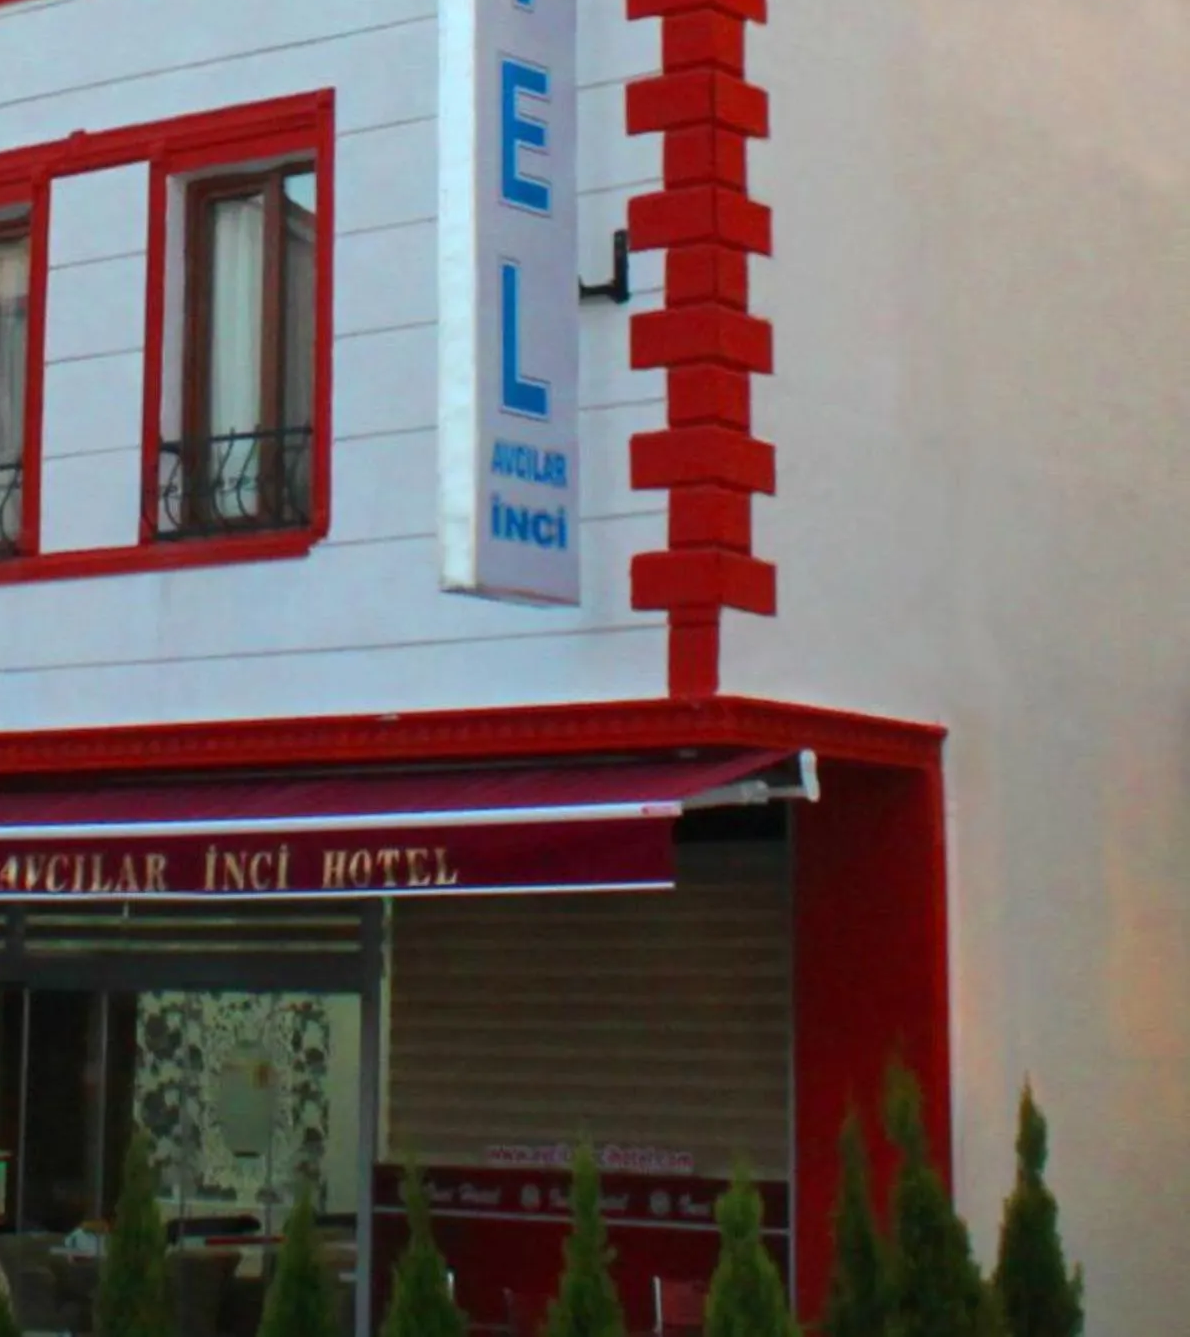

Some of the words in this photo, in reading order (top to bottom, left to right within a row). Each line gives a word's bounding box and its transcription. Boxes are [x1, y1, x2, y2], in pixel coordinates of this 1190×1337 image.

[491, 439, 567, 487] AVCILAR
[490, 492, 567, 550] İNCİ
[205, 844, 291, 891] İNCİ
[323, 847, 459, 889] HOTEL
